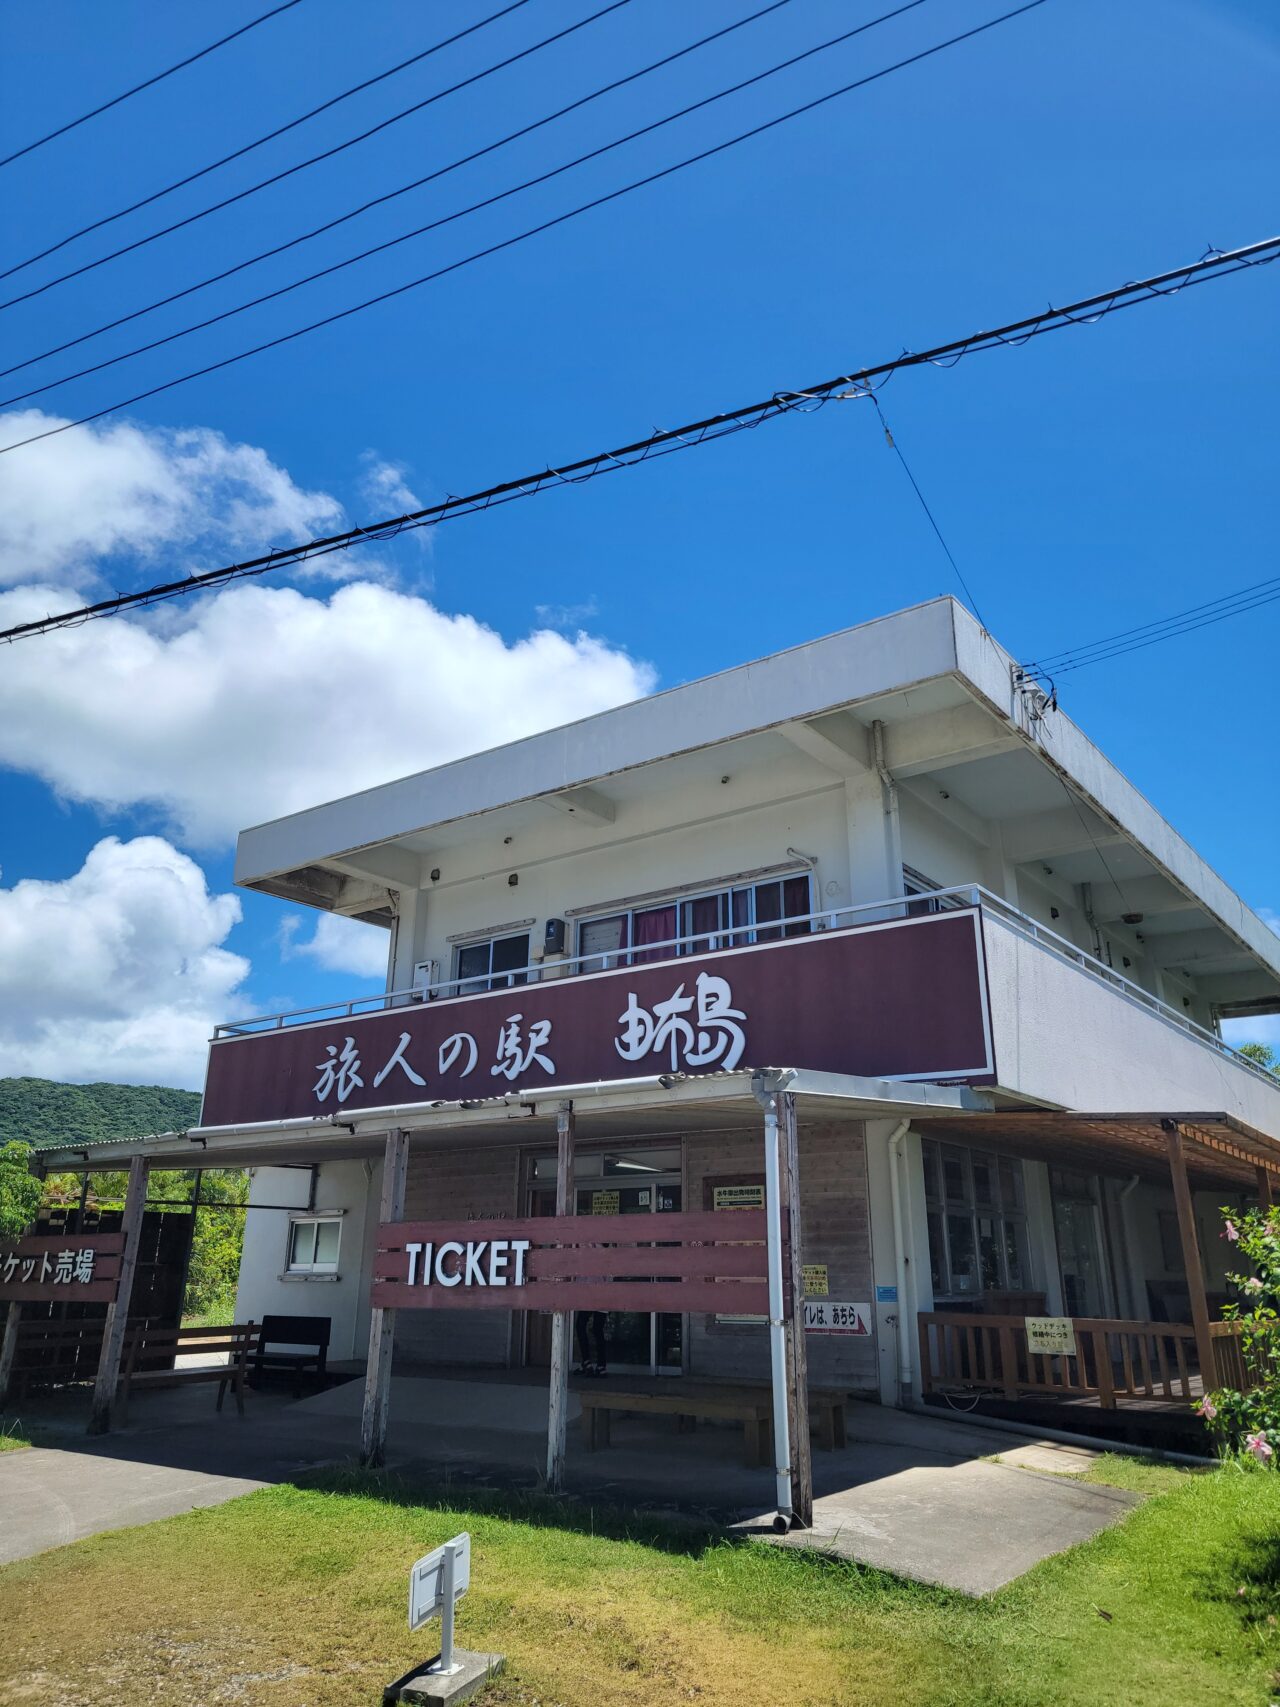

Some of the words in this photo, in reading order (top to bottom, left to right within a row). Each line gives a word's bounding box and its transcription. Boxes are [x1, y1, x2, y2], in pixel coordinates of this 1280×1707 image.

[312, 1012, 556, 1104] 旅人の駅
[405, 1240, 530, 1287] TICKET
